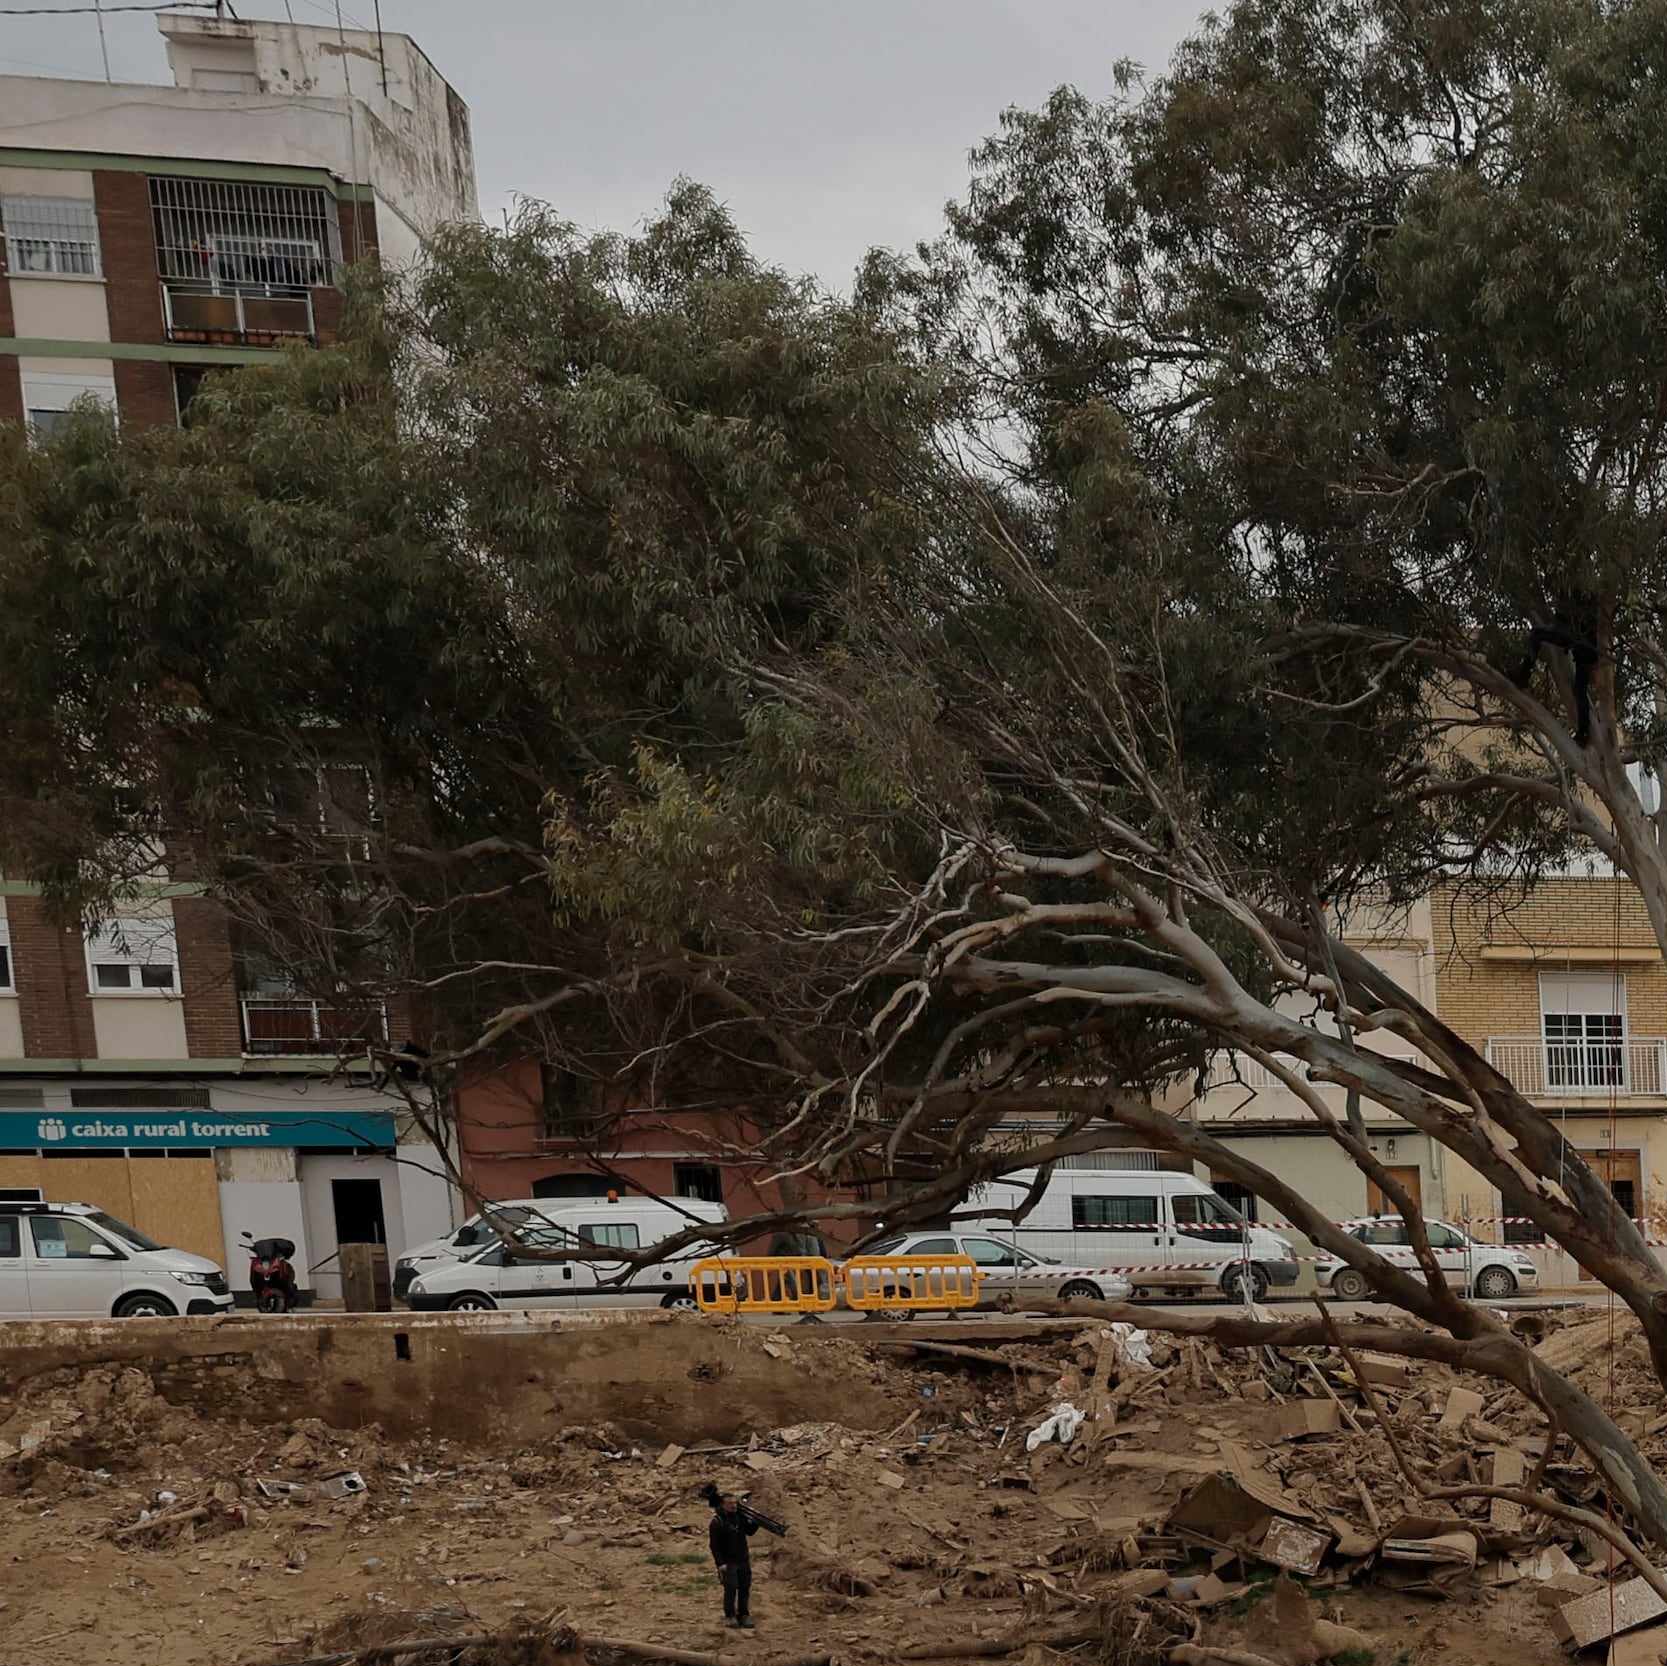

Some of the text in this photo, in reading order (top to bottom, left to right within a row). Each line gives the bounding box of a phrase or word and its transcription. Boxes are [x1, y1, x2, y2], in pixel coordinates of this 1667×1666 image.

[72, 1120, 270, 1137] caixa rural torrent
